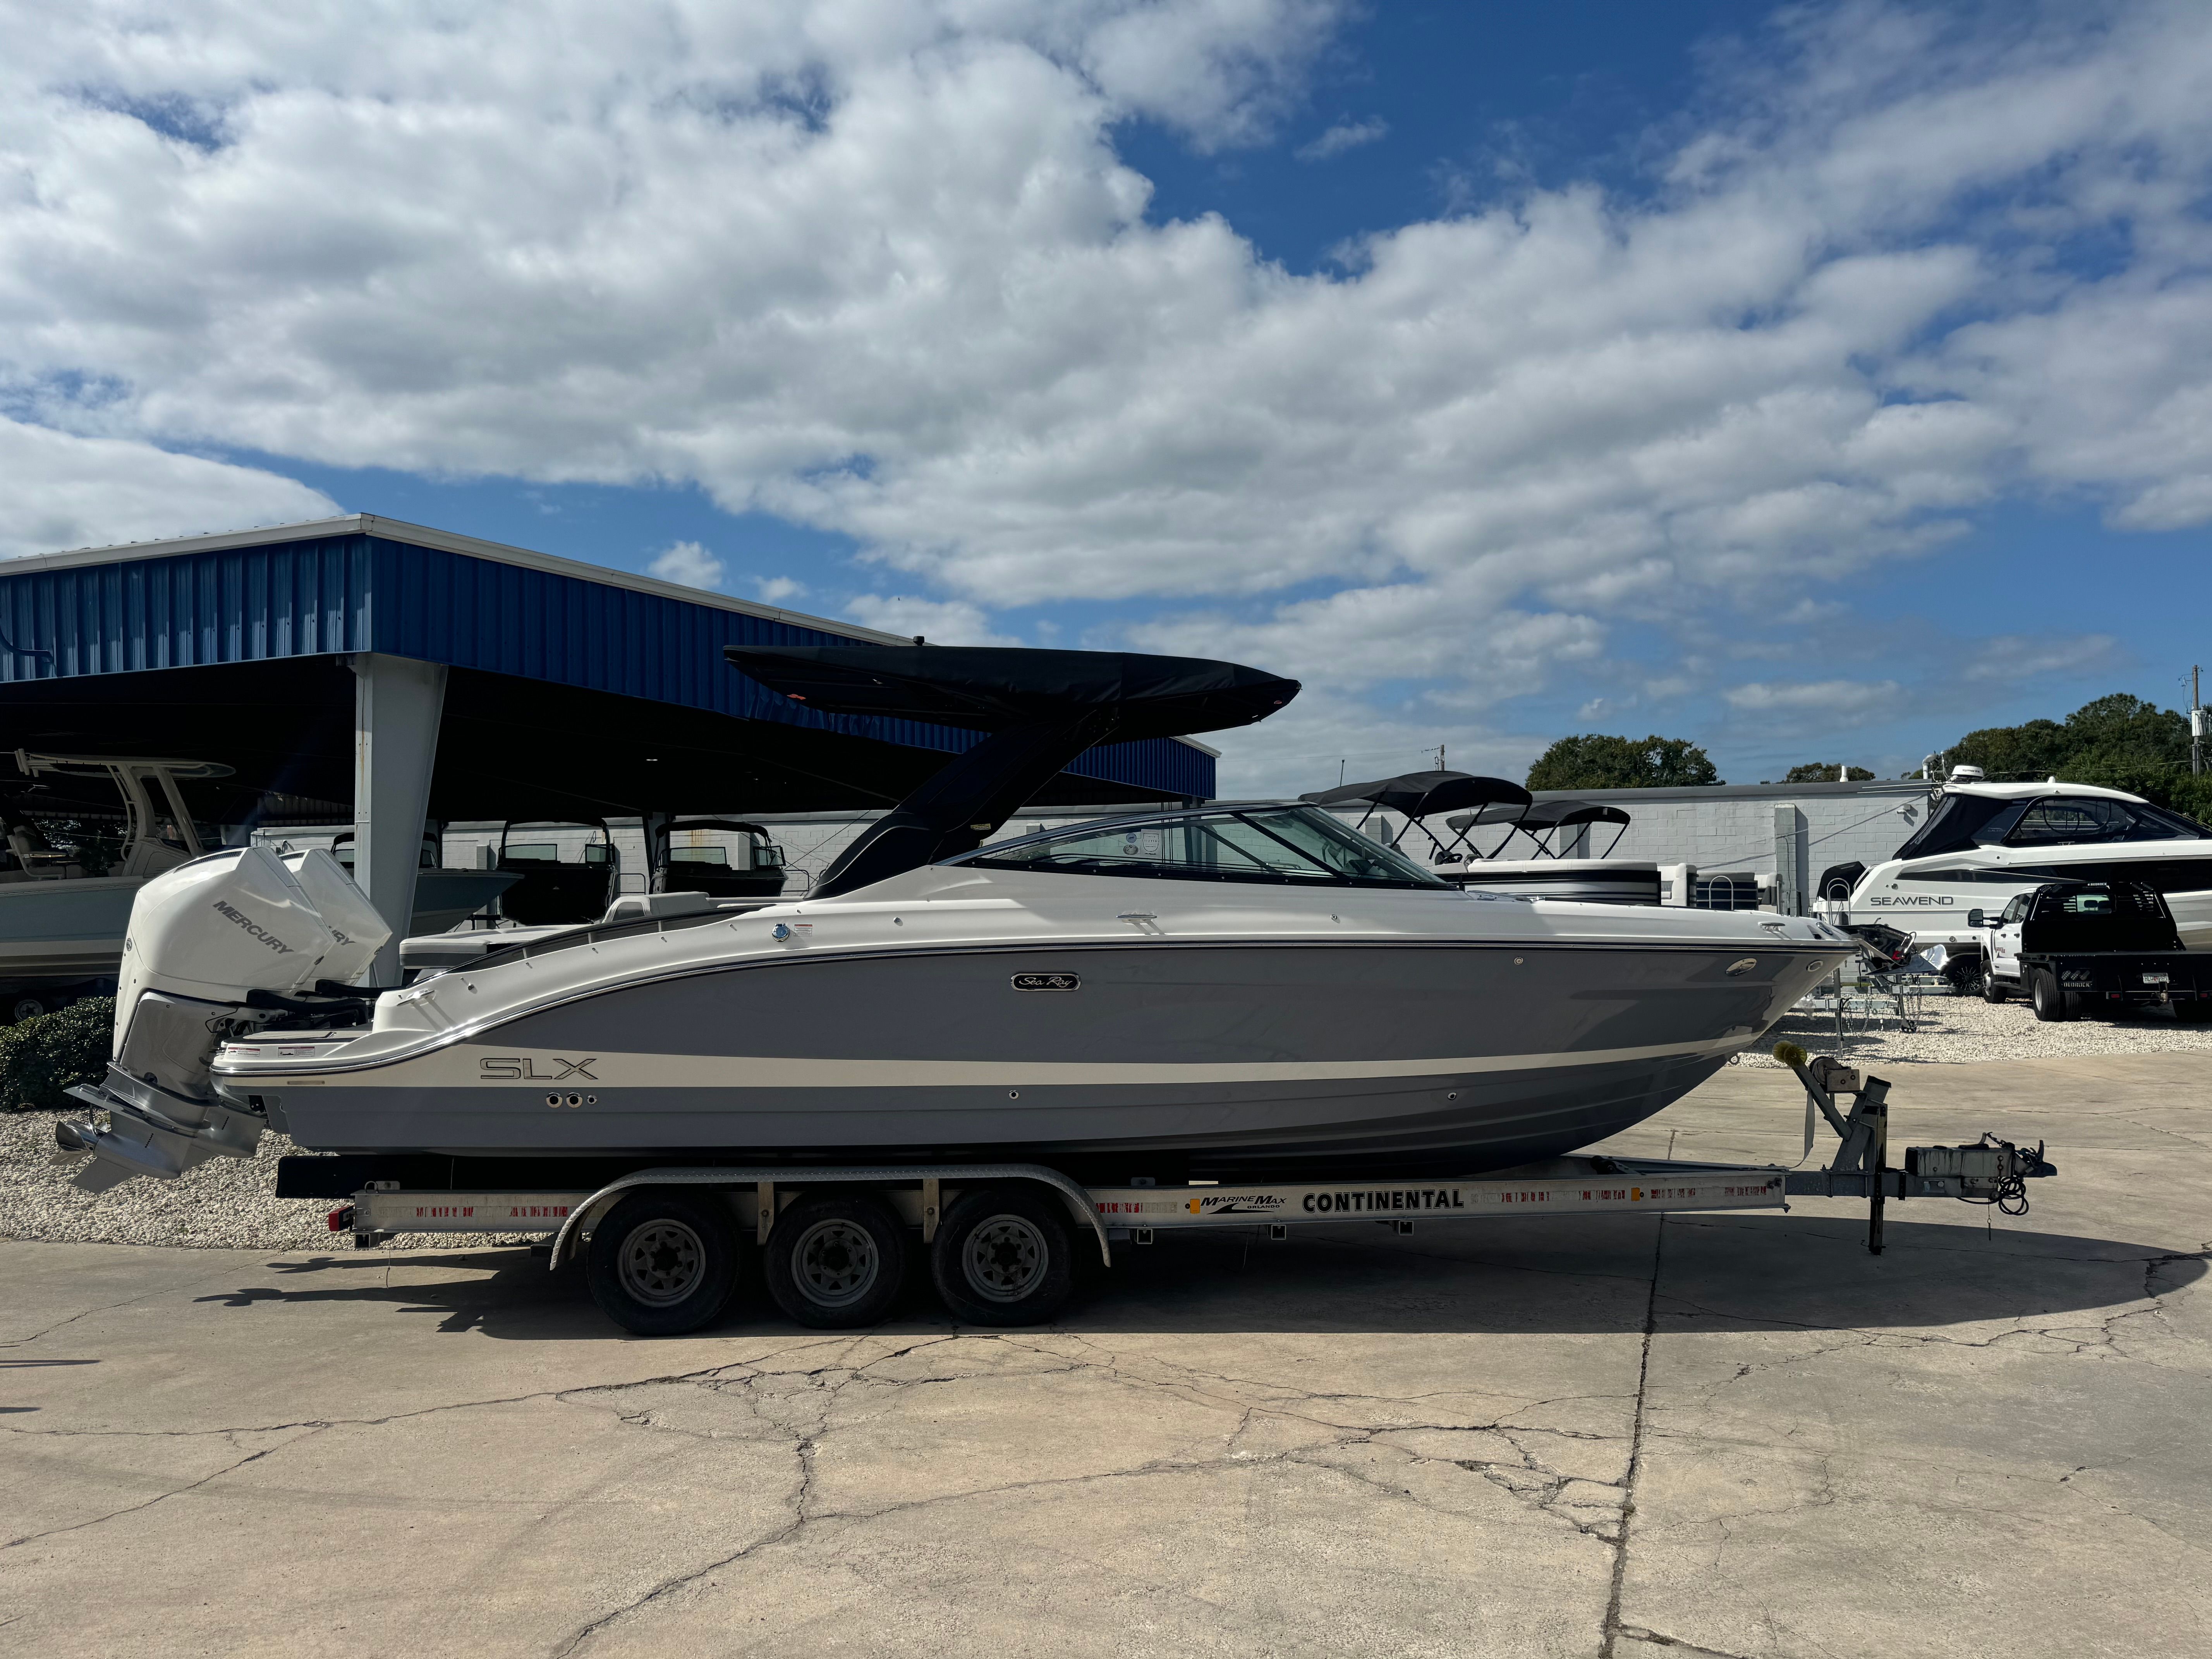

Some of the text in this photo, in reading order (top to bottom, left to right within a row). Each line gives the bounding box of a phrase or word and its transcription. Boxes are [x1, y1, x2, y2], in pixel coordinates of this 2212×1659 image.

[1870, 896, 1954, 906] SEAWEND
[213, 901, 294, 954] MERCURY
[1019, 976, 1073, 988] Sea Ray
[480, 1058, 598, 1080] SLX
[1302, 1189, 1464, 1213] CONTINENTAL
